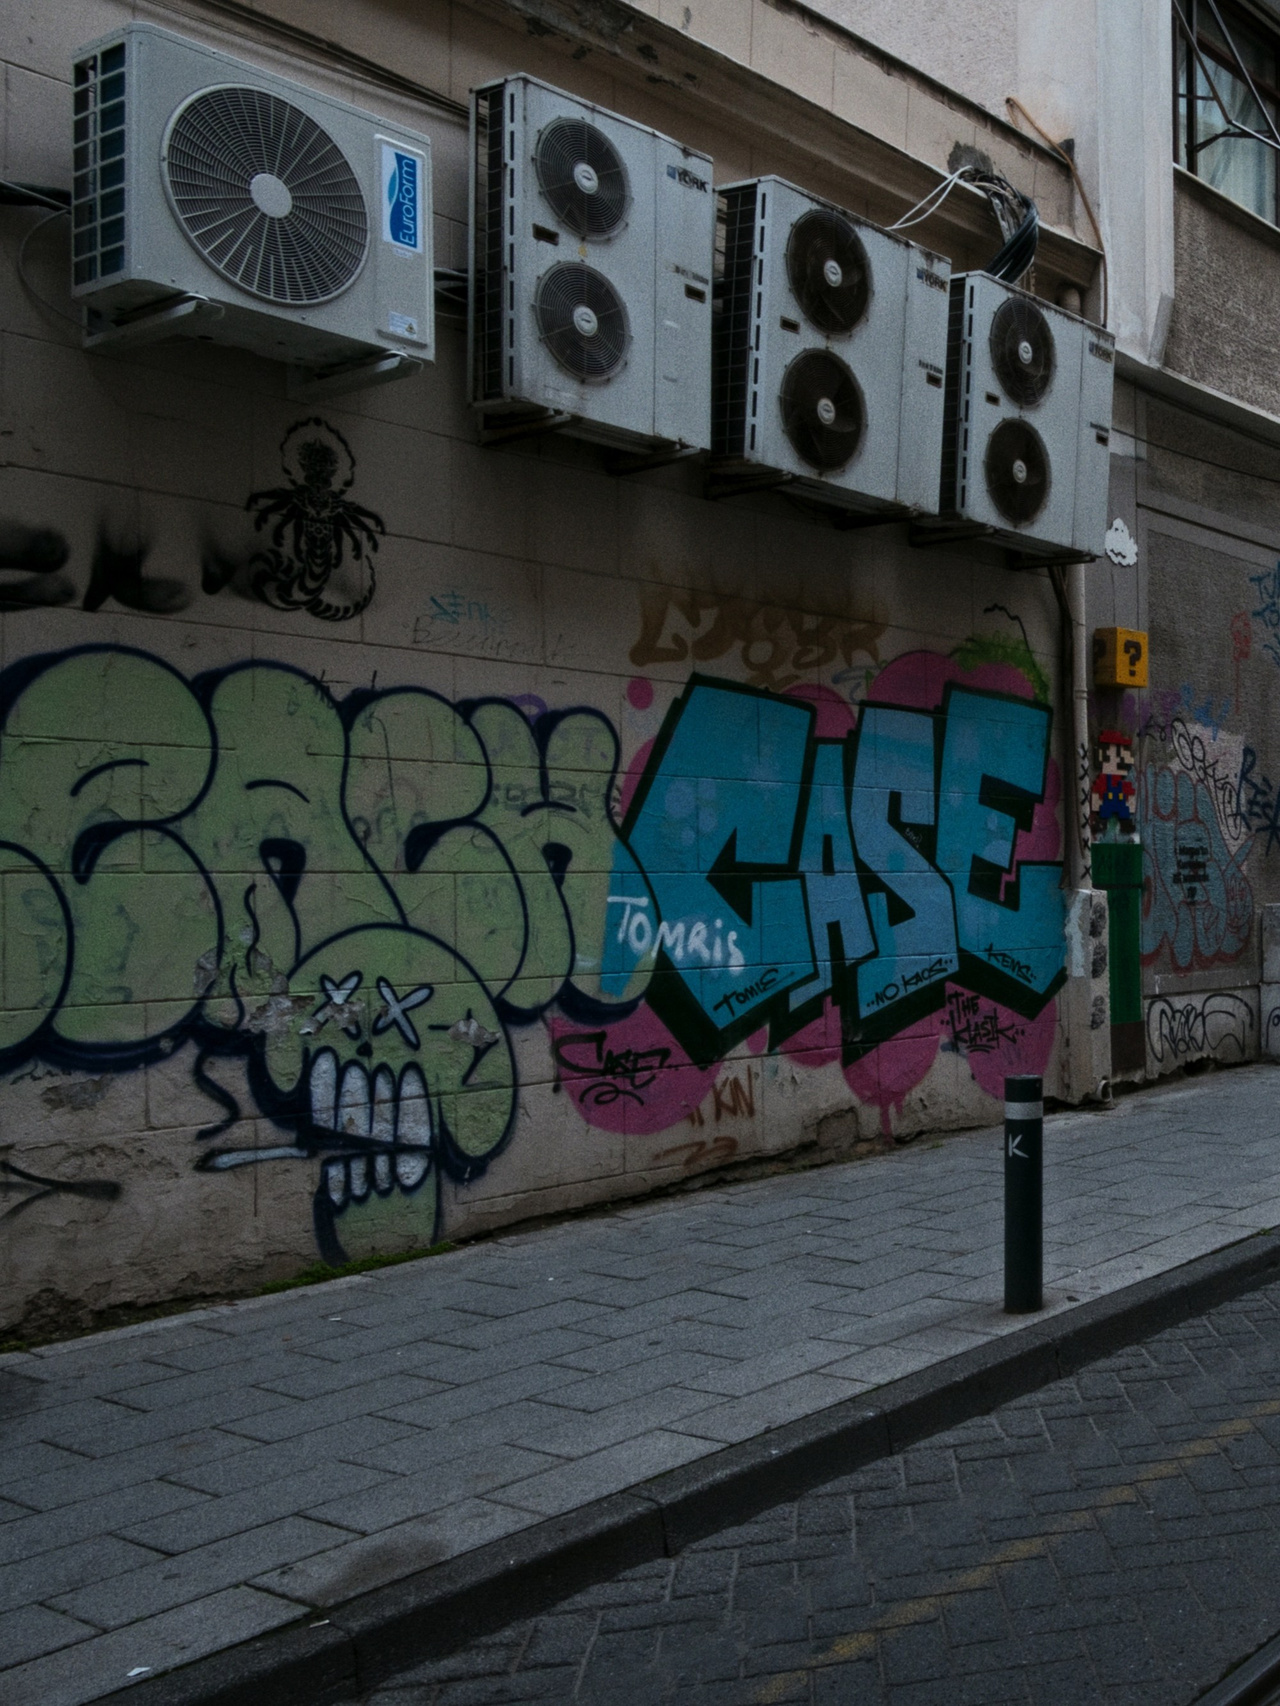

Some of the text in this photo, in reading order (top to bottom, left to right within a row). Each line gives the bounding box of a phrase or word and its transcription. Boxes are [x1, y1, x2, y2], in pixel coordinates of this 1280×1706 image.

[400, 158, 415, 245] EuroForm
[677, 166, 709, 193] YORK
[618, 672, 1068, 1070] CASE
[1008, 1133, 1029, 1159] K
